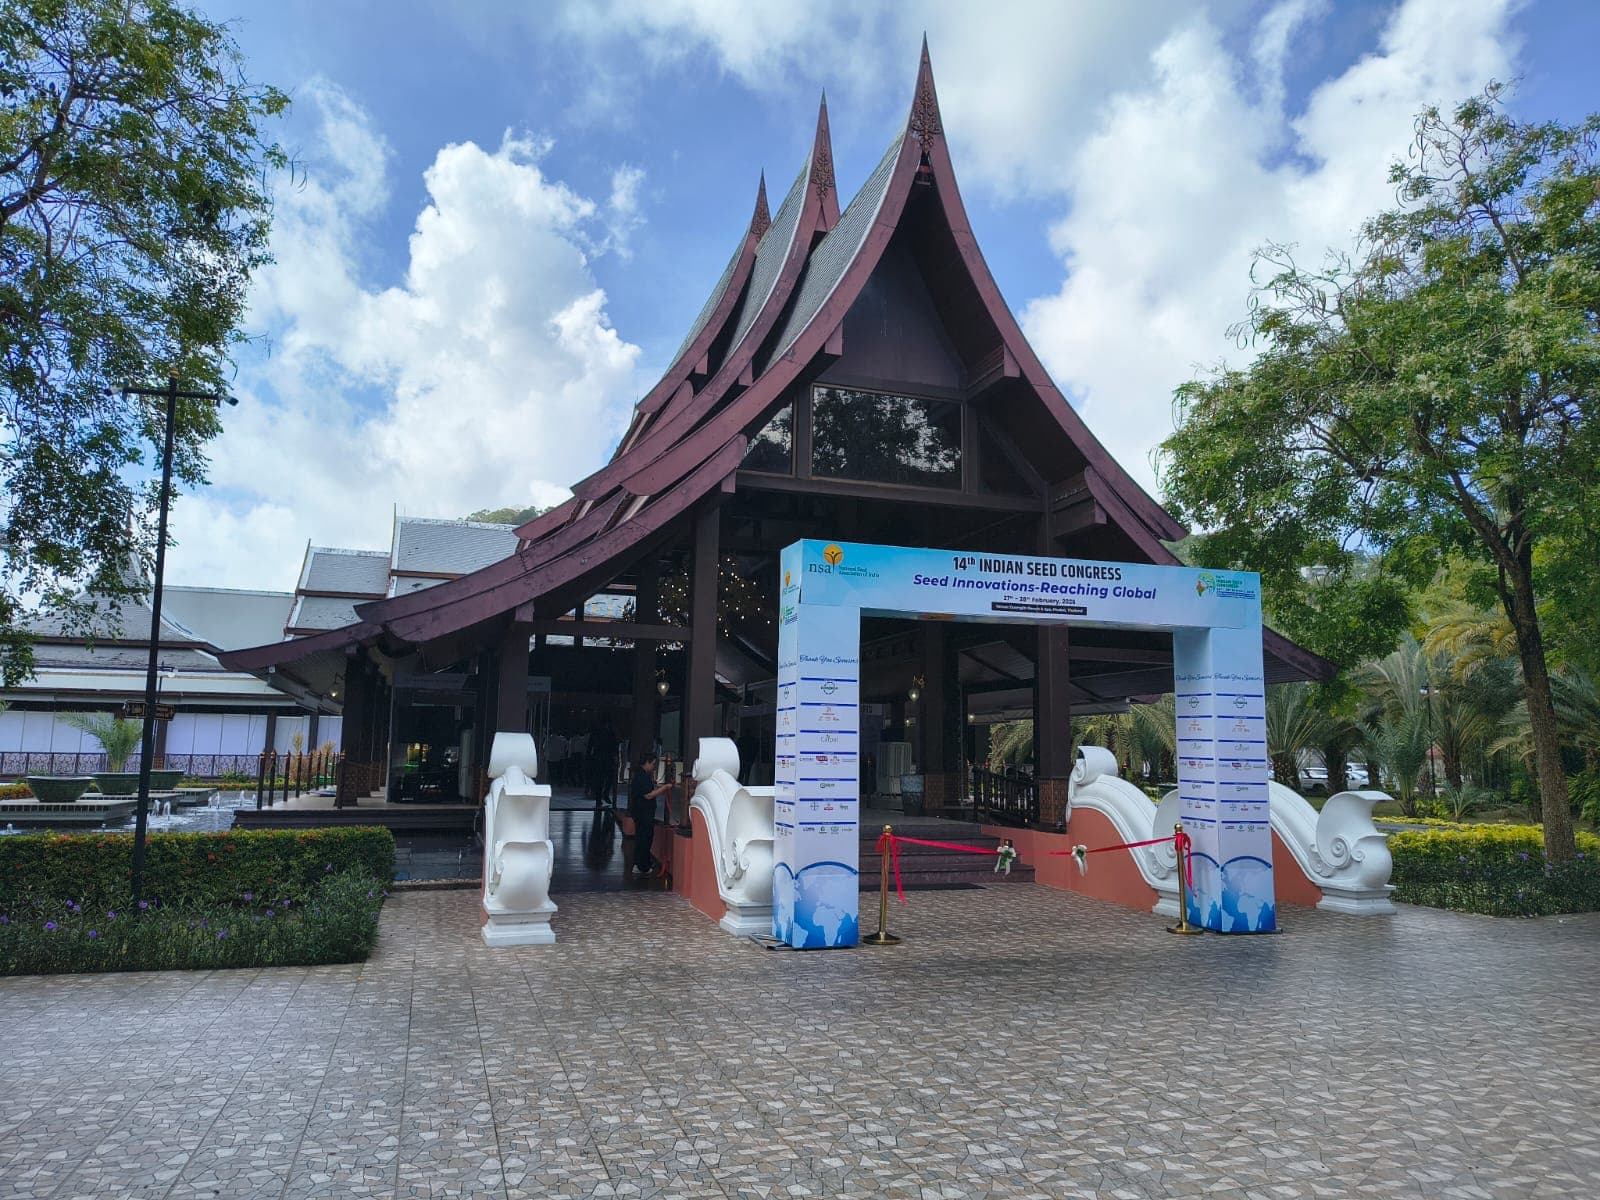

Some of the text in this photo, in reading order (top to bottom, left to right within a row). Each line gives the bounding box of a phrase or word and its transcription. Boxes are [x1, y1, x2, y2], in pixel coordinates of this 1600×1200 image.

[953, 556, 1122, 581] 14th INDIAN SEED CONGRESS
[913, 574, 1157, 600] Seed Innovations-Reaching Global
